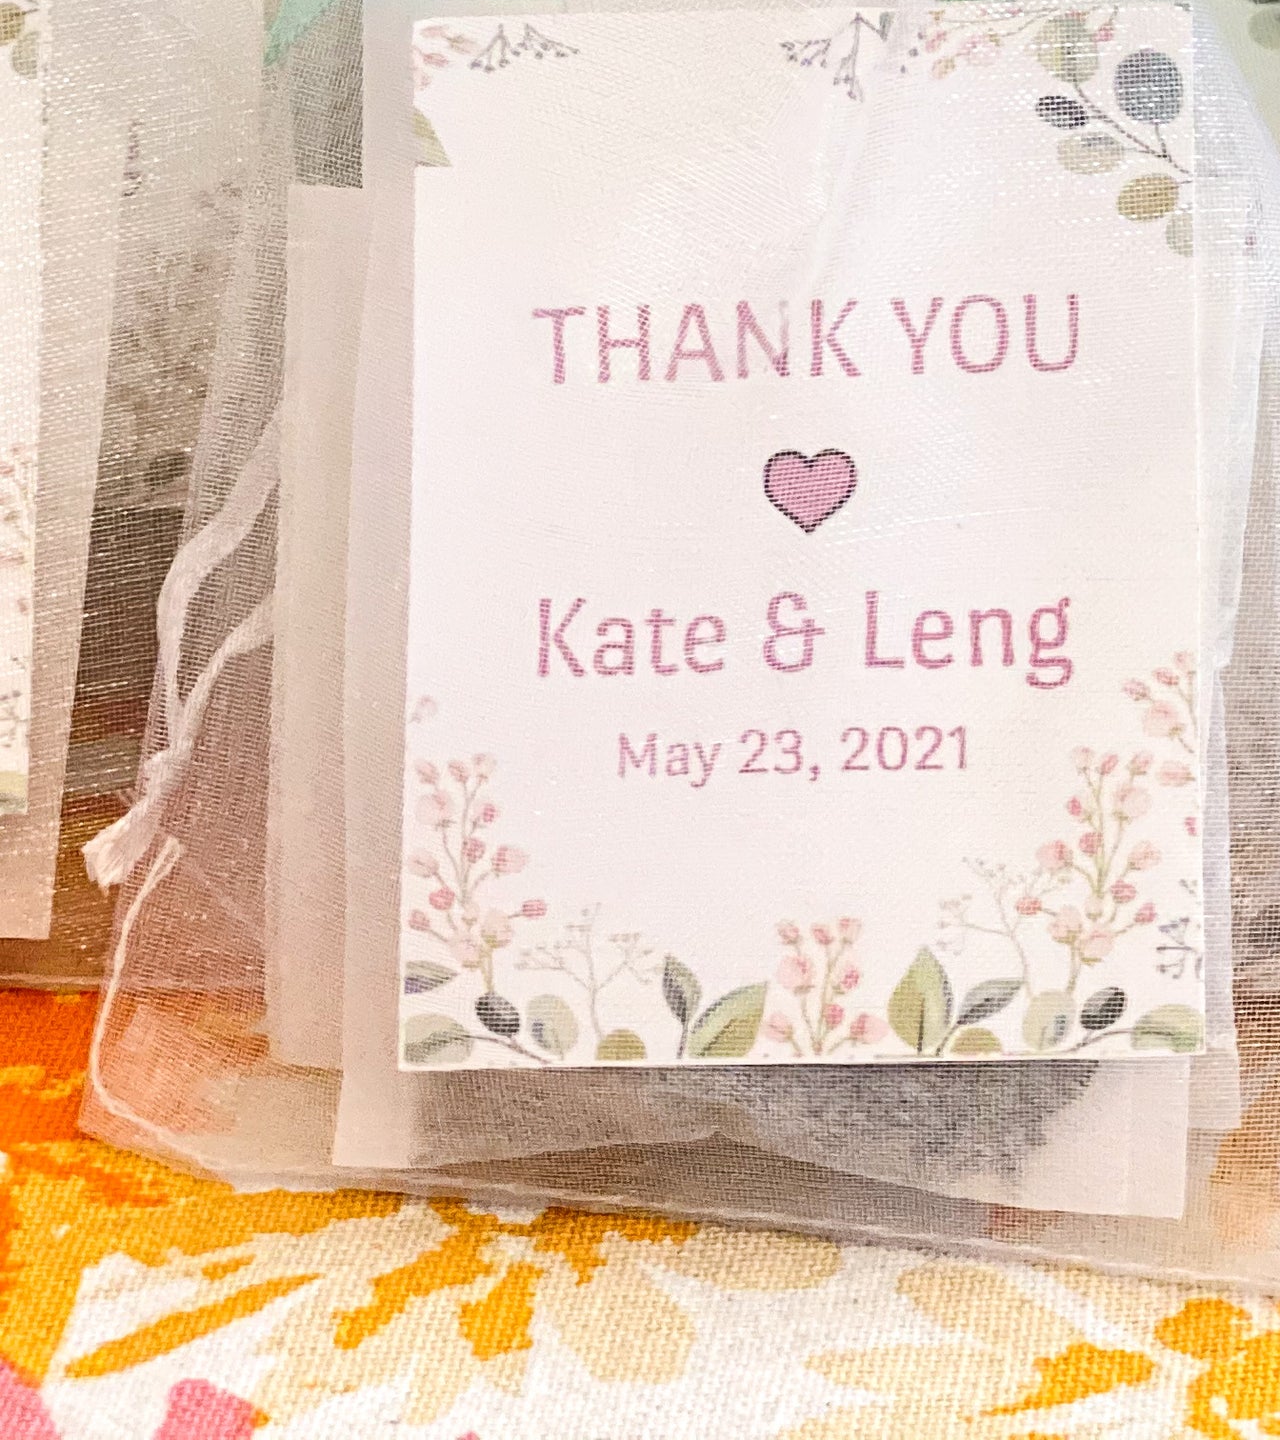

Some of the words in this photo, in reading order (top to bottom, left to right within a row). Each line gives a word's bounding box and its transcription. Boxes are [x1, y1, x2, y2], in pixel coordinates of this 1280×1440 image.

[532, 298, 861, 385] THANK
[891, 293, 1080, 375] YOU
[534, 596, 728, 678] Kate
[762, 591, 826, 672] &
[864, 590, 1074, 690] Leng
[617, 733, 721, 788] May
[738, 730, 822, 782] 23,
[840, 726, 968, 772] 2021
